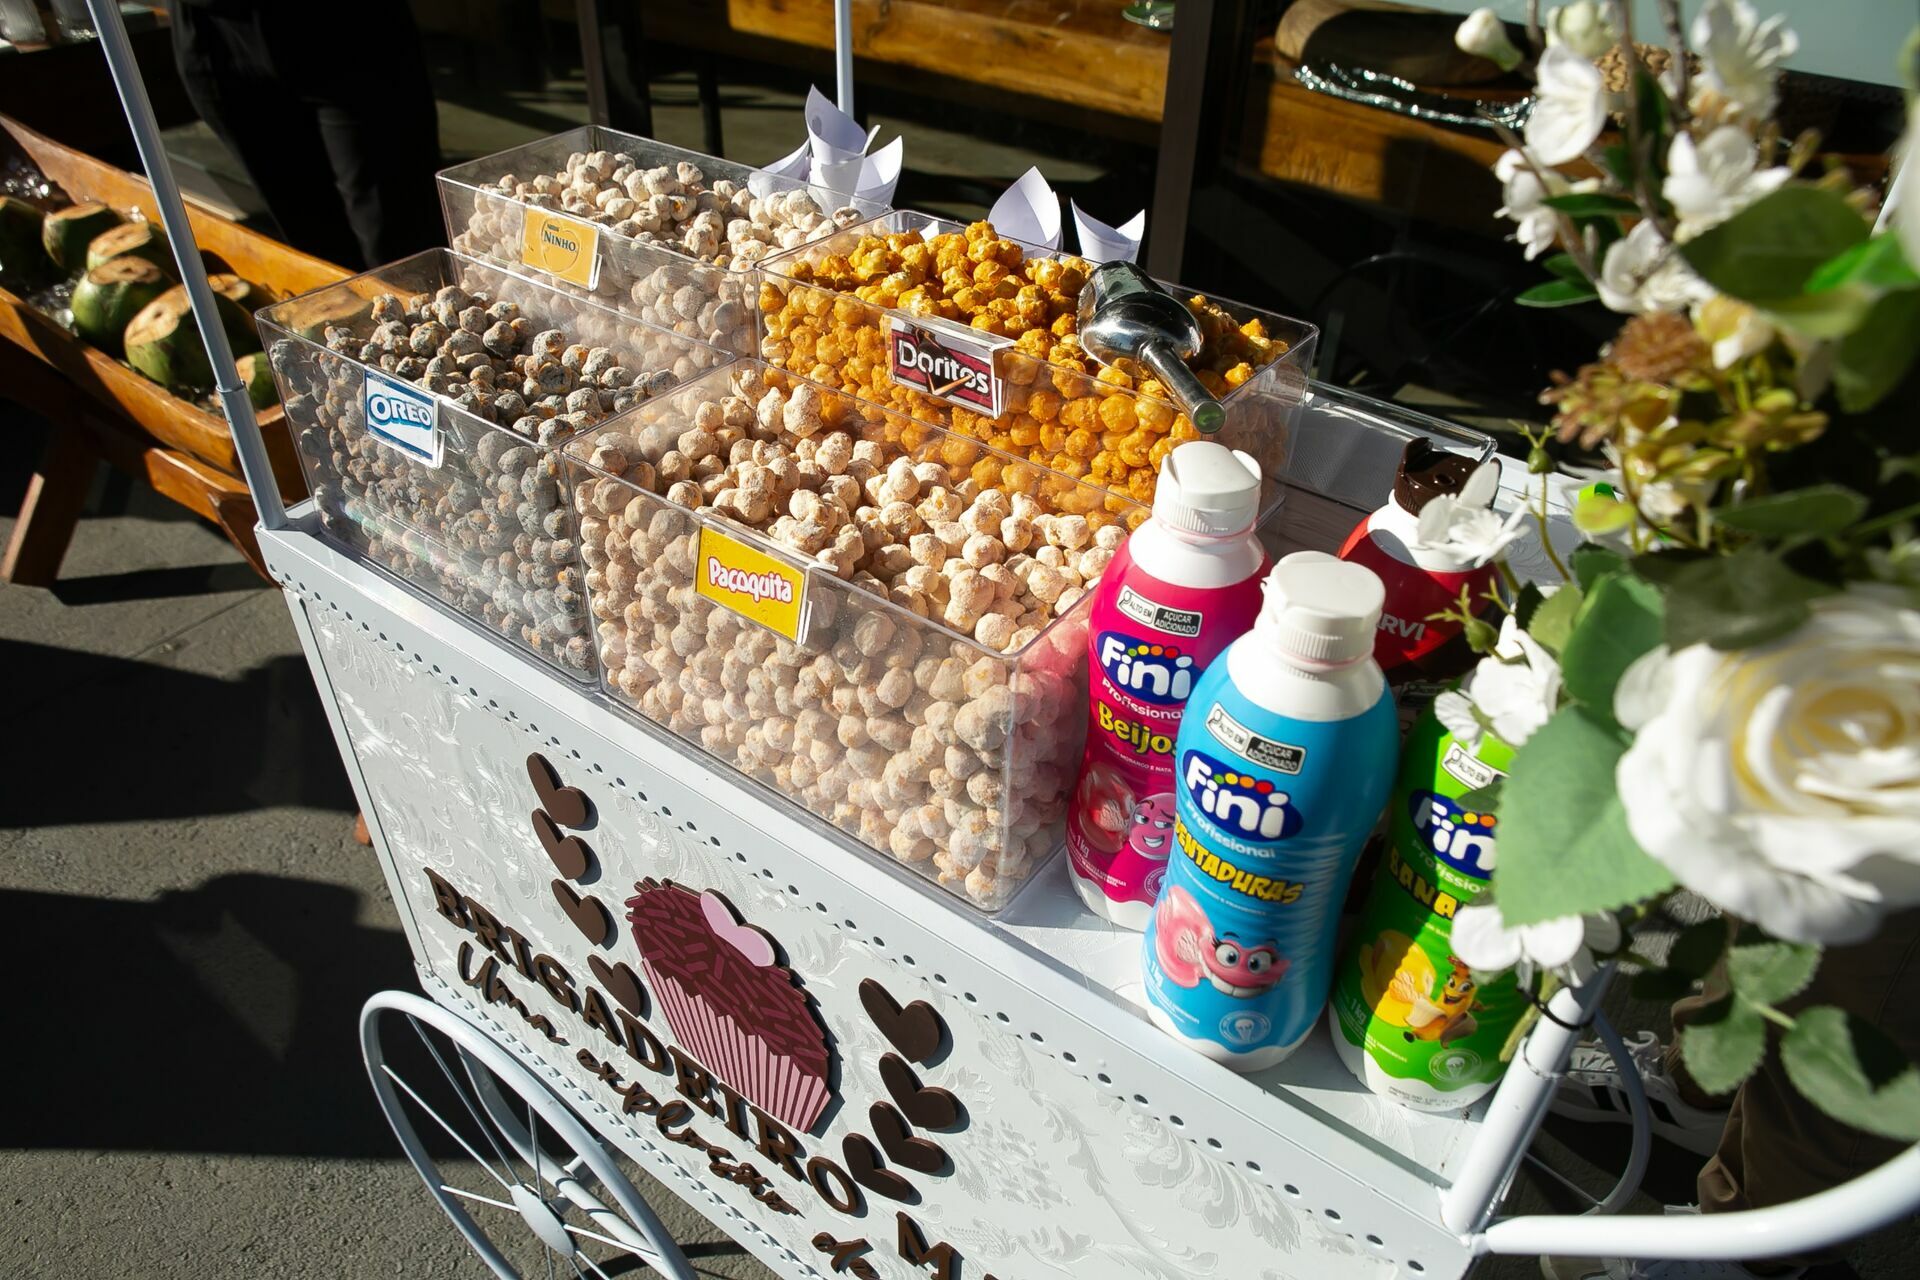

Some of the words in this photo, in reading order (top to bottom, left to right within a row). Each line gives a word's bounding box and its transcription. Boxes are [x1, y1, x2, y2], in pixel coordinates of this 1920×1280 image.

[544, 231, 576, 252] NINHO
[898, 340, 990, 394] Doritos
[369, 394, 432, 428] OREO
[708, 557, 793, 604] Paçoquita
[1130, 601, 1143, 613] ALTO
[1143, 608, 1153, 618] EM
[1155, 618, 1198, 634] ADICIONADO
[1376, 613, 1426, 640] RVI
[1101, 636, 1193, 700] Fini
[1219, 723, 1234, 738] ALTO
[1234, 734, 1245, 745] EM
[1247, 748, 1298, 770] ADICIONADO
[1186, 755, 1289, 839] Fini
[1186, 800, 1276, 859] Profissional
[1414, 796, 1496, 871] Fin
[1175, 811, 1304, 905] DENTADURAS
[1389, 846, 1460, 919] BANA
[1411, 838, 1486, 893] Profissio
[458, 941, 570, 1047] Uma
[423, 867, 860, 1215] BRIGADEIRO
